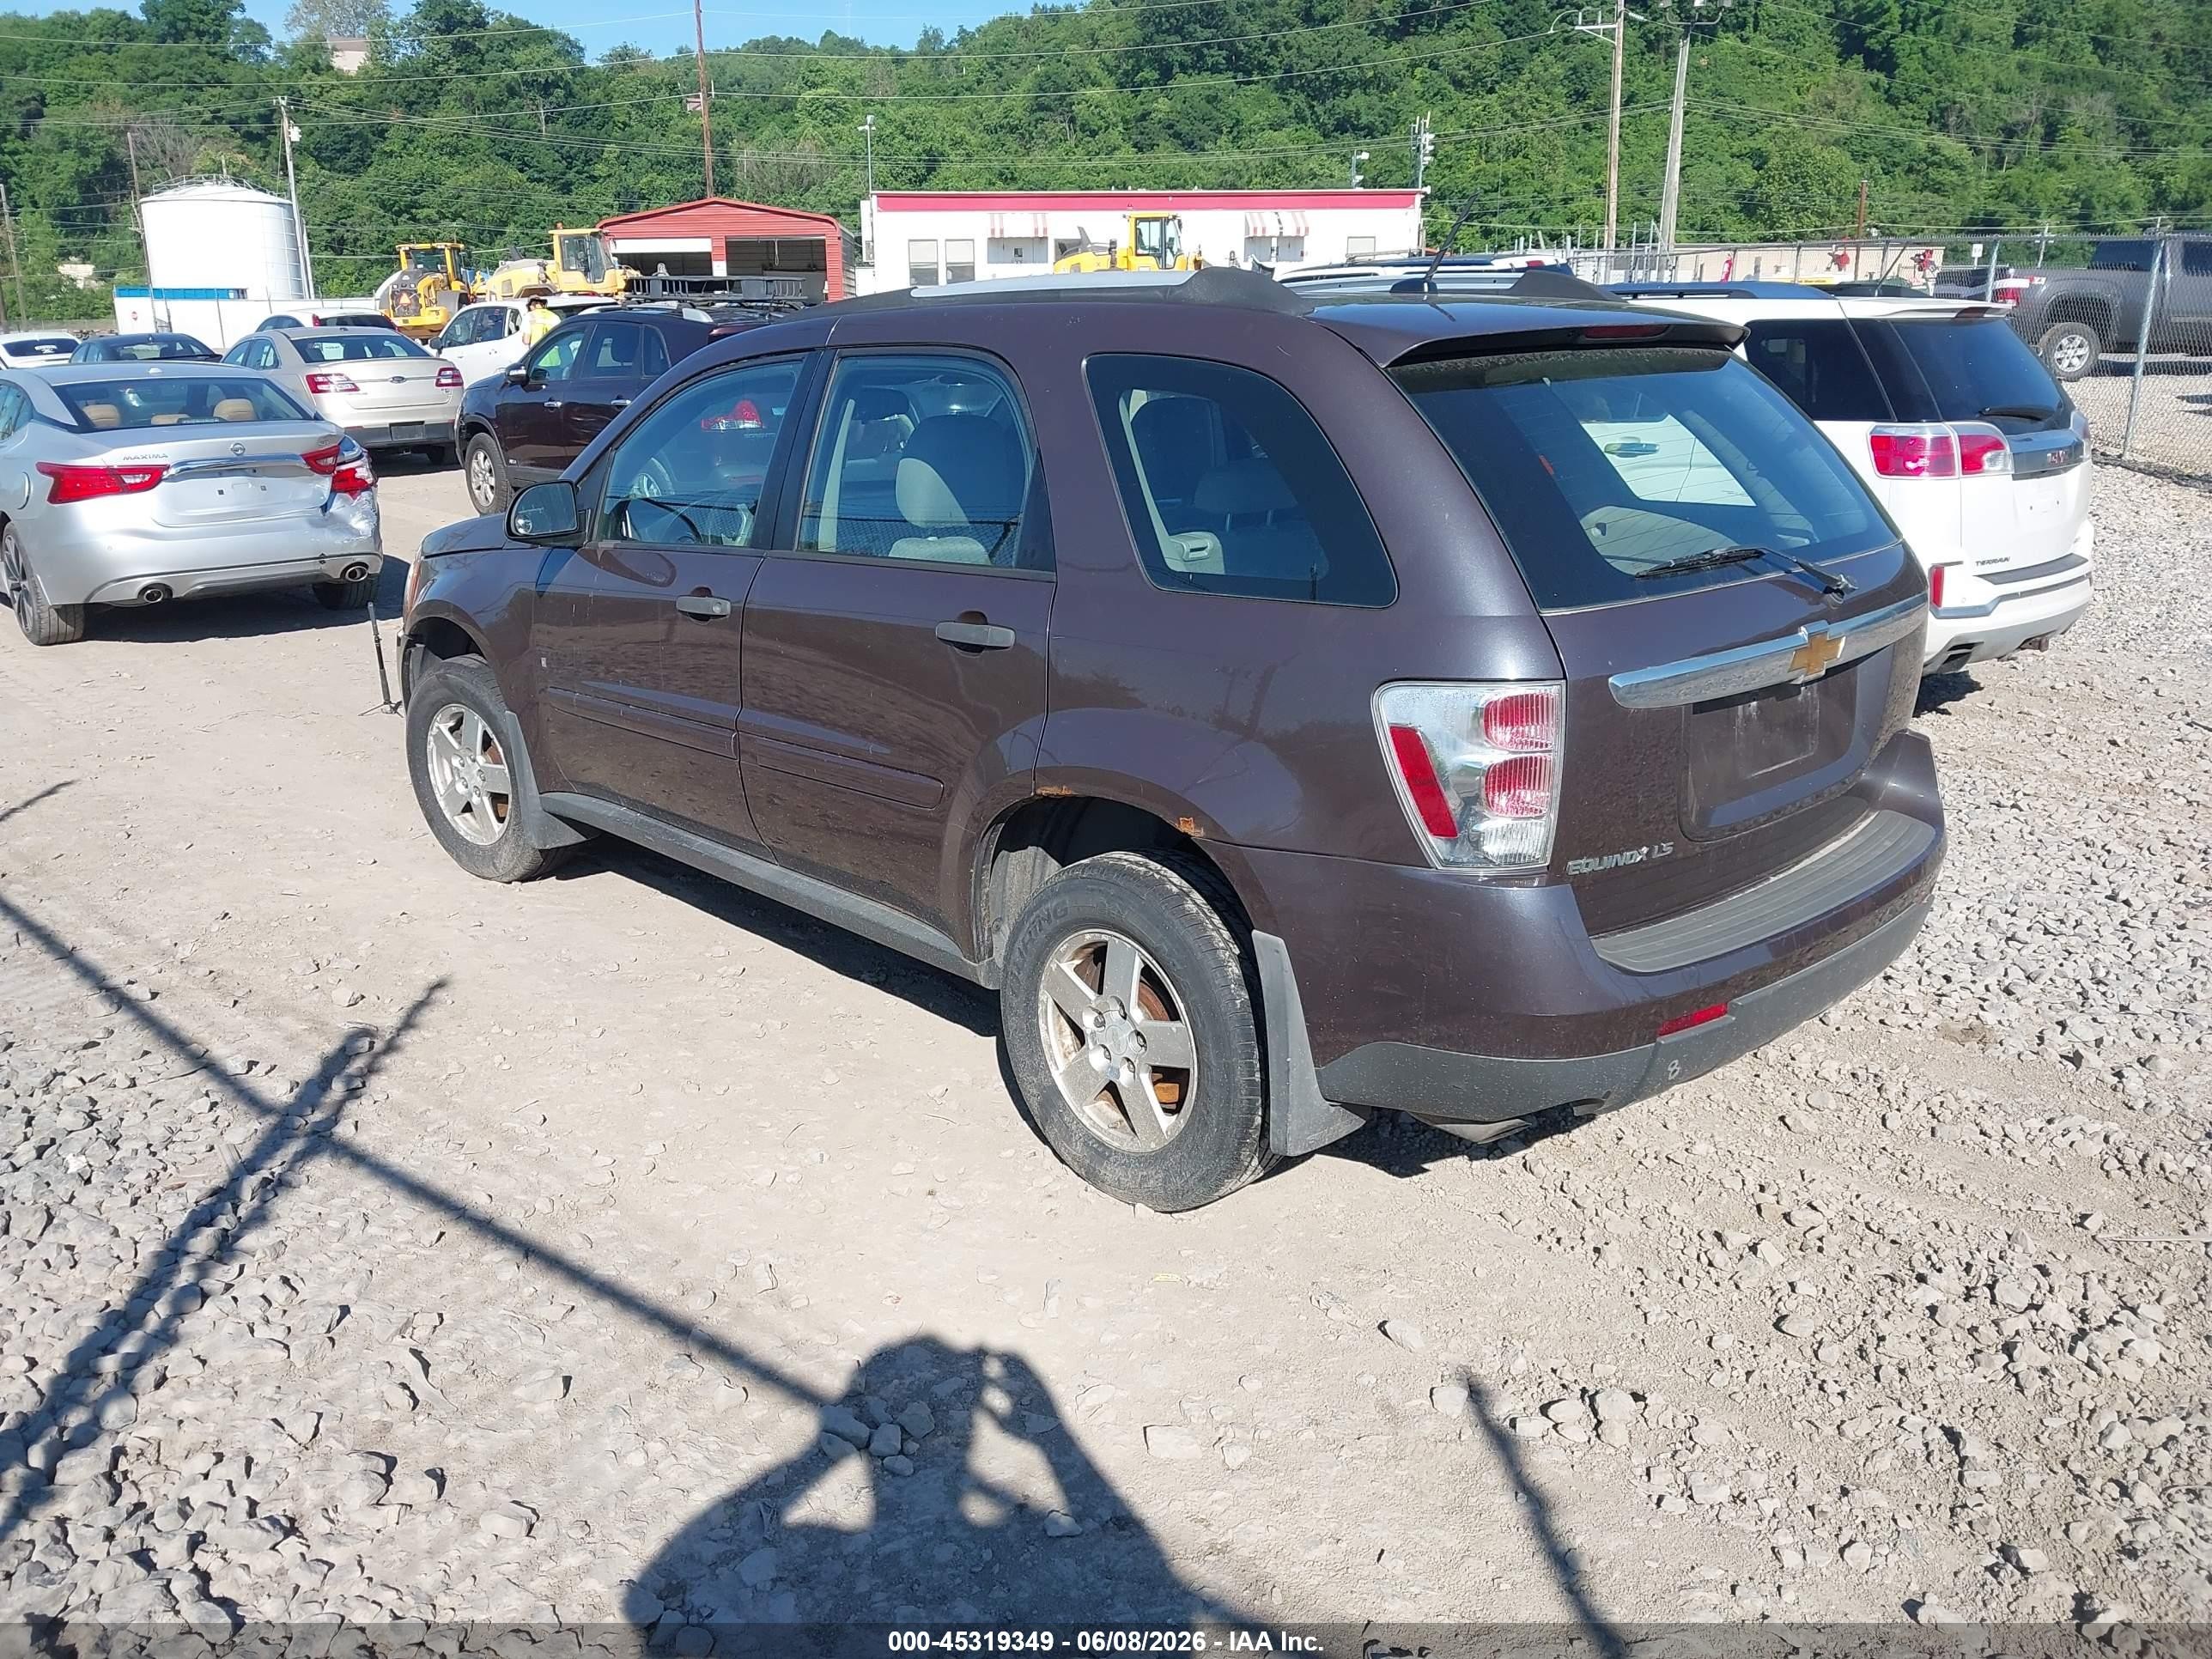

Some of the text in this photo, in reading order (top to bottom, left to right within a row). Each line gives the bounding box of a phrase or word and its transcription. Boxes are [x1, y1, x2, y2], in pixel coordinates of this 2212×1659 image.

[123, 453, 169, 461] MAXIMA
[1566, 842, 1674, 875] EQUINOX LS
